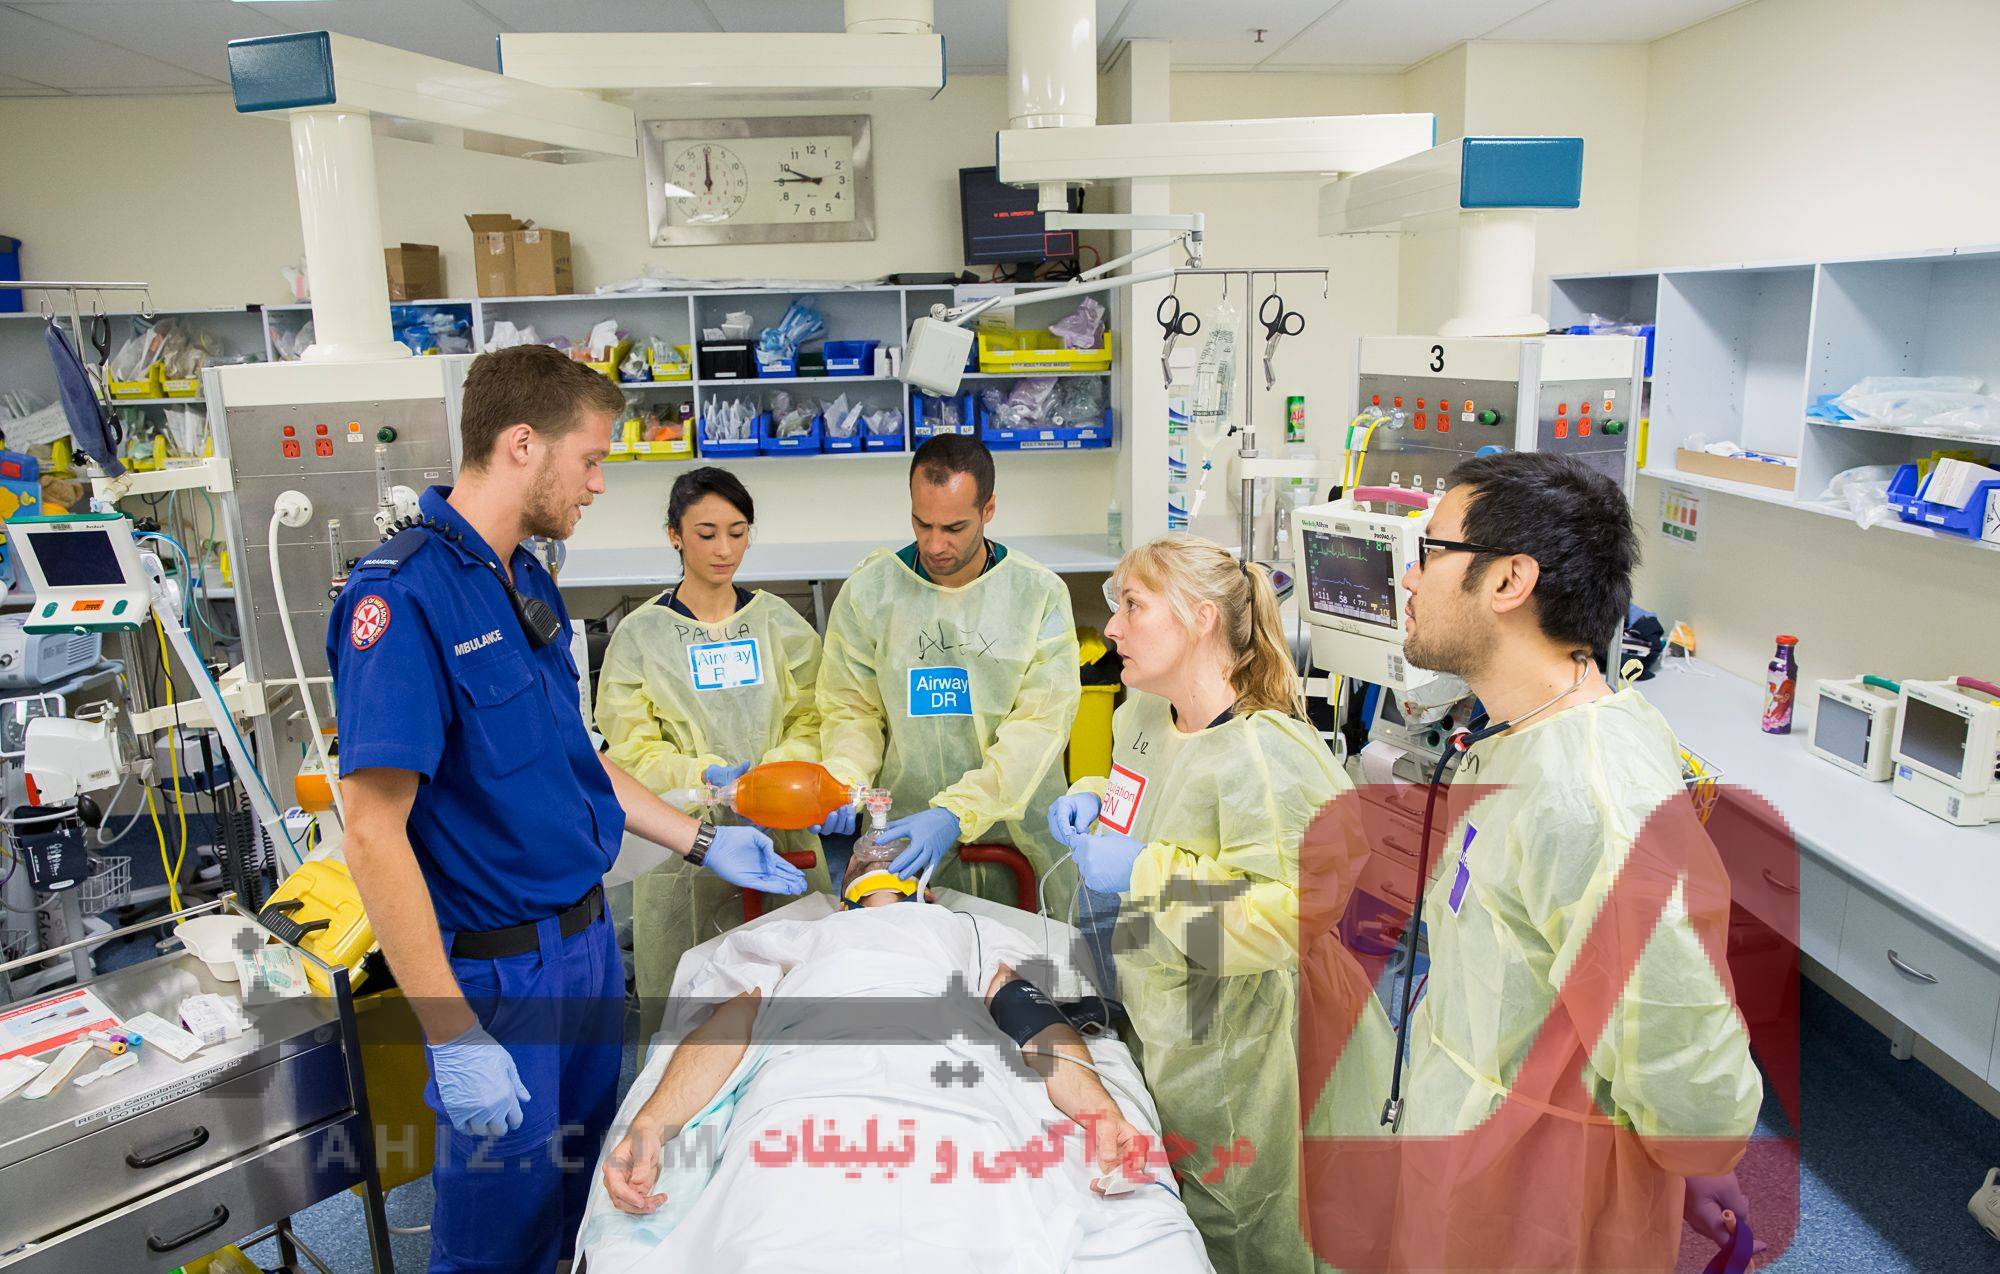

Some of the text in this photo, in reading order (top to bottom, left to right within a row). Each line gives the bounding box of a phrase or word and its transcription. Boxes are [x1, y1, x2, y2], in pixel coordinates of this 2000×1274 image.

[703, 146, 712, 154] 60
[806, 145, 816, 155] 12
[824, 149, 828, 158] 1
[791, 151, 799, 160] 11
[780, 163, 790, 172] 10
[835, 160, 841, 170] 2
[839, 175, 845, 185] 3
[783, 192, 789, 201] 8
[834, 192, 840, 200] 4
[794, 204, 800, 215] 7
[810, 207, 816, 216] 6
[825, 203, 832, 212] 5
[1430, 344, 1445, 373] 3
[363, 558, 399, 566] PARAMEDIC
[674, 622, 750, 643] PAULA
[916, 675, 968, 694] Airway
[931, 691, 957, 708] DR
[77, 1103, 122, 1126] RESUS
[123, 1078, 188, 1107] Cannulation
[191, 1064, 225, 1083] Trolley
[110, 1079, 213, 1122] DO NOT REMOVE
